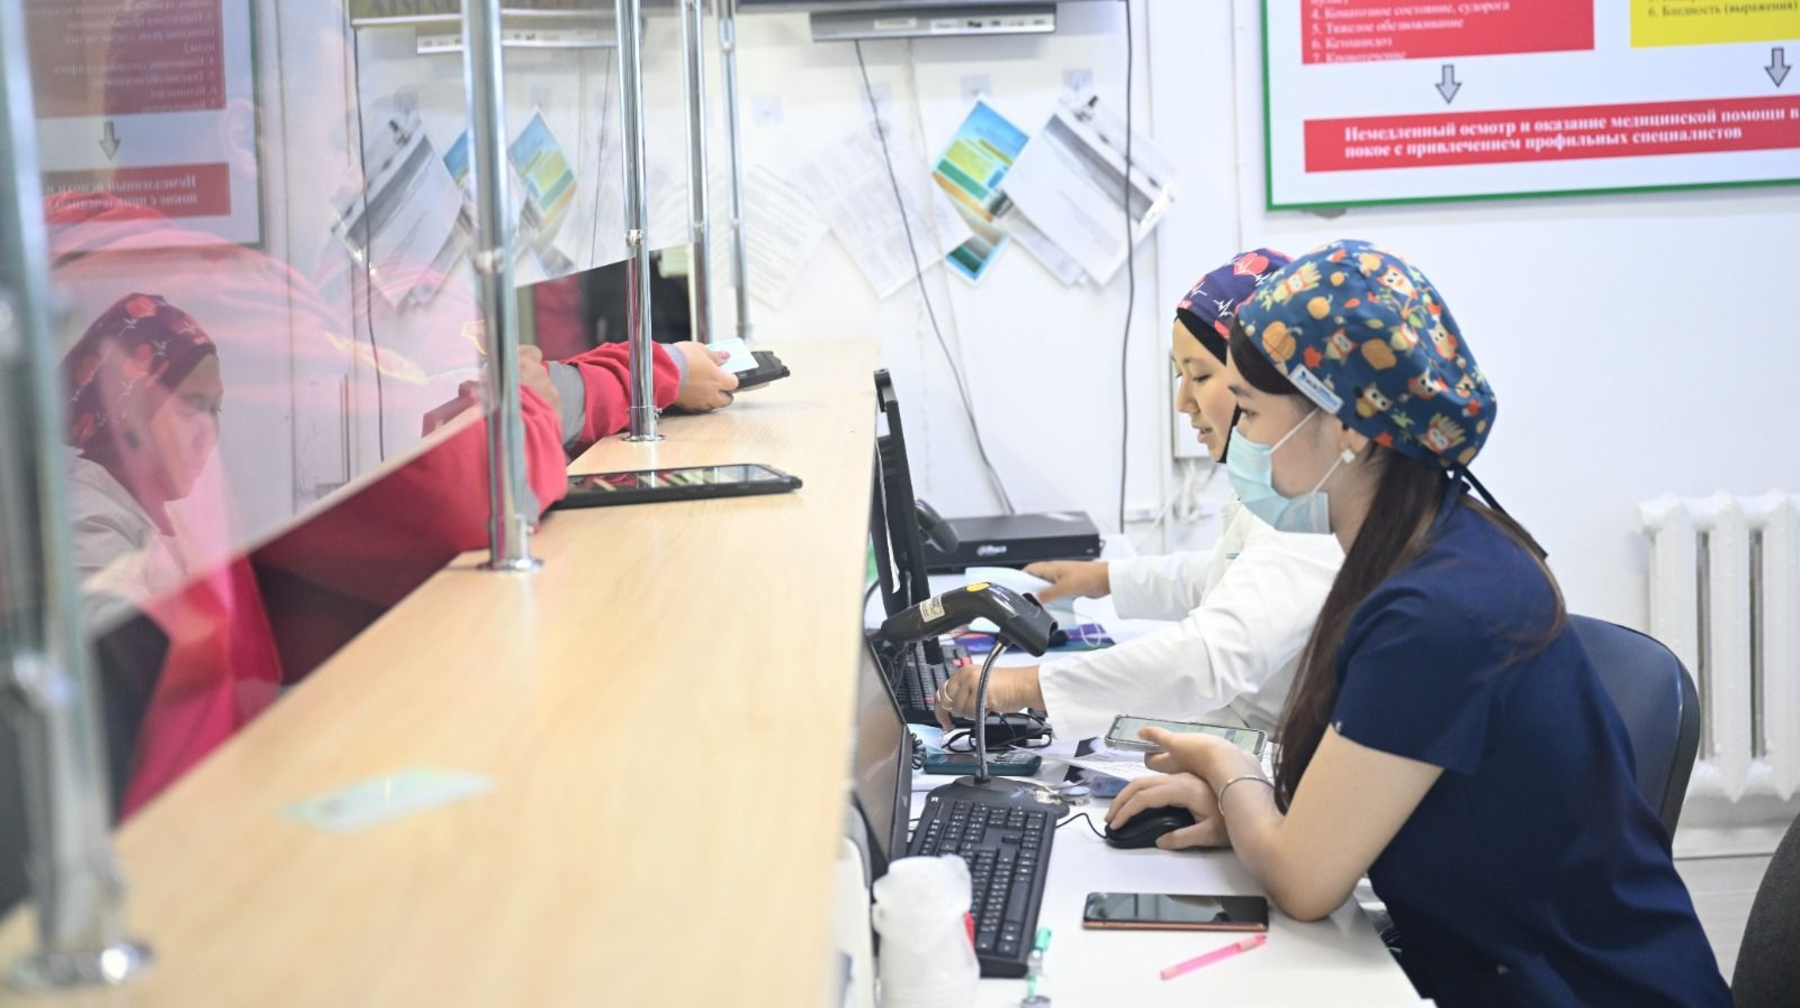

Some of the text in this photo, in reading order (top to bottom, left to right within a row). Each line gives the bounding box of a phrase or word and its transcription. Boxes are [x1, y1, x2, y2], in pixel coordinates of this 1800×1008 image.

[1662, 5, 1721, 18] Бледность
[1345, 122, 1456, 142] Немедленный
[1460, 119, 1516, 137] осмотр
[1520, 120, 1530, 133] и
[1534, 116, 1607, 132] оказание
[1611, 108, 1717, 128] медицинской
[1721, 107, 1785, 124] помощи
[1345, 126, 1743, 159] покое с привлечением профильных специалистов
